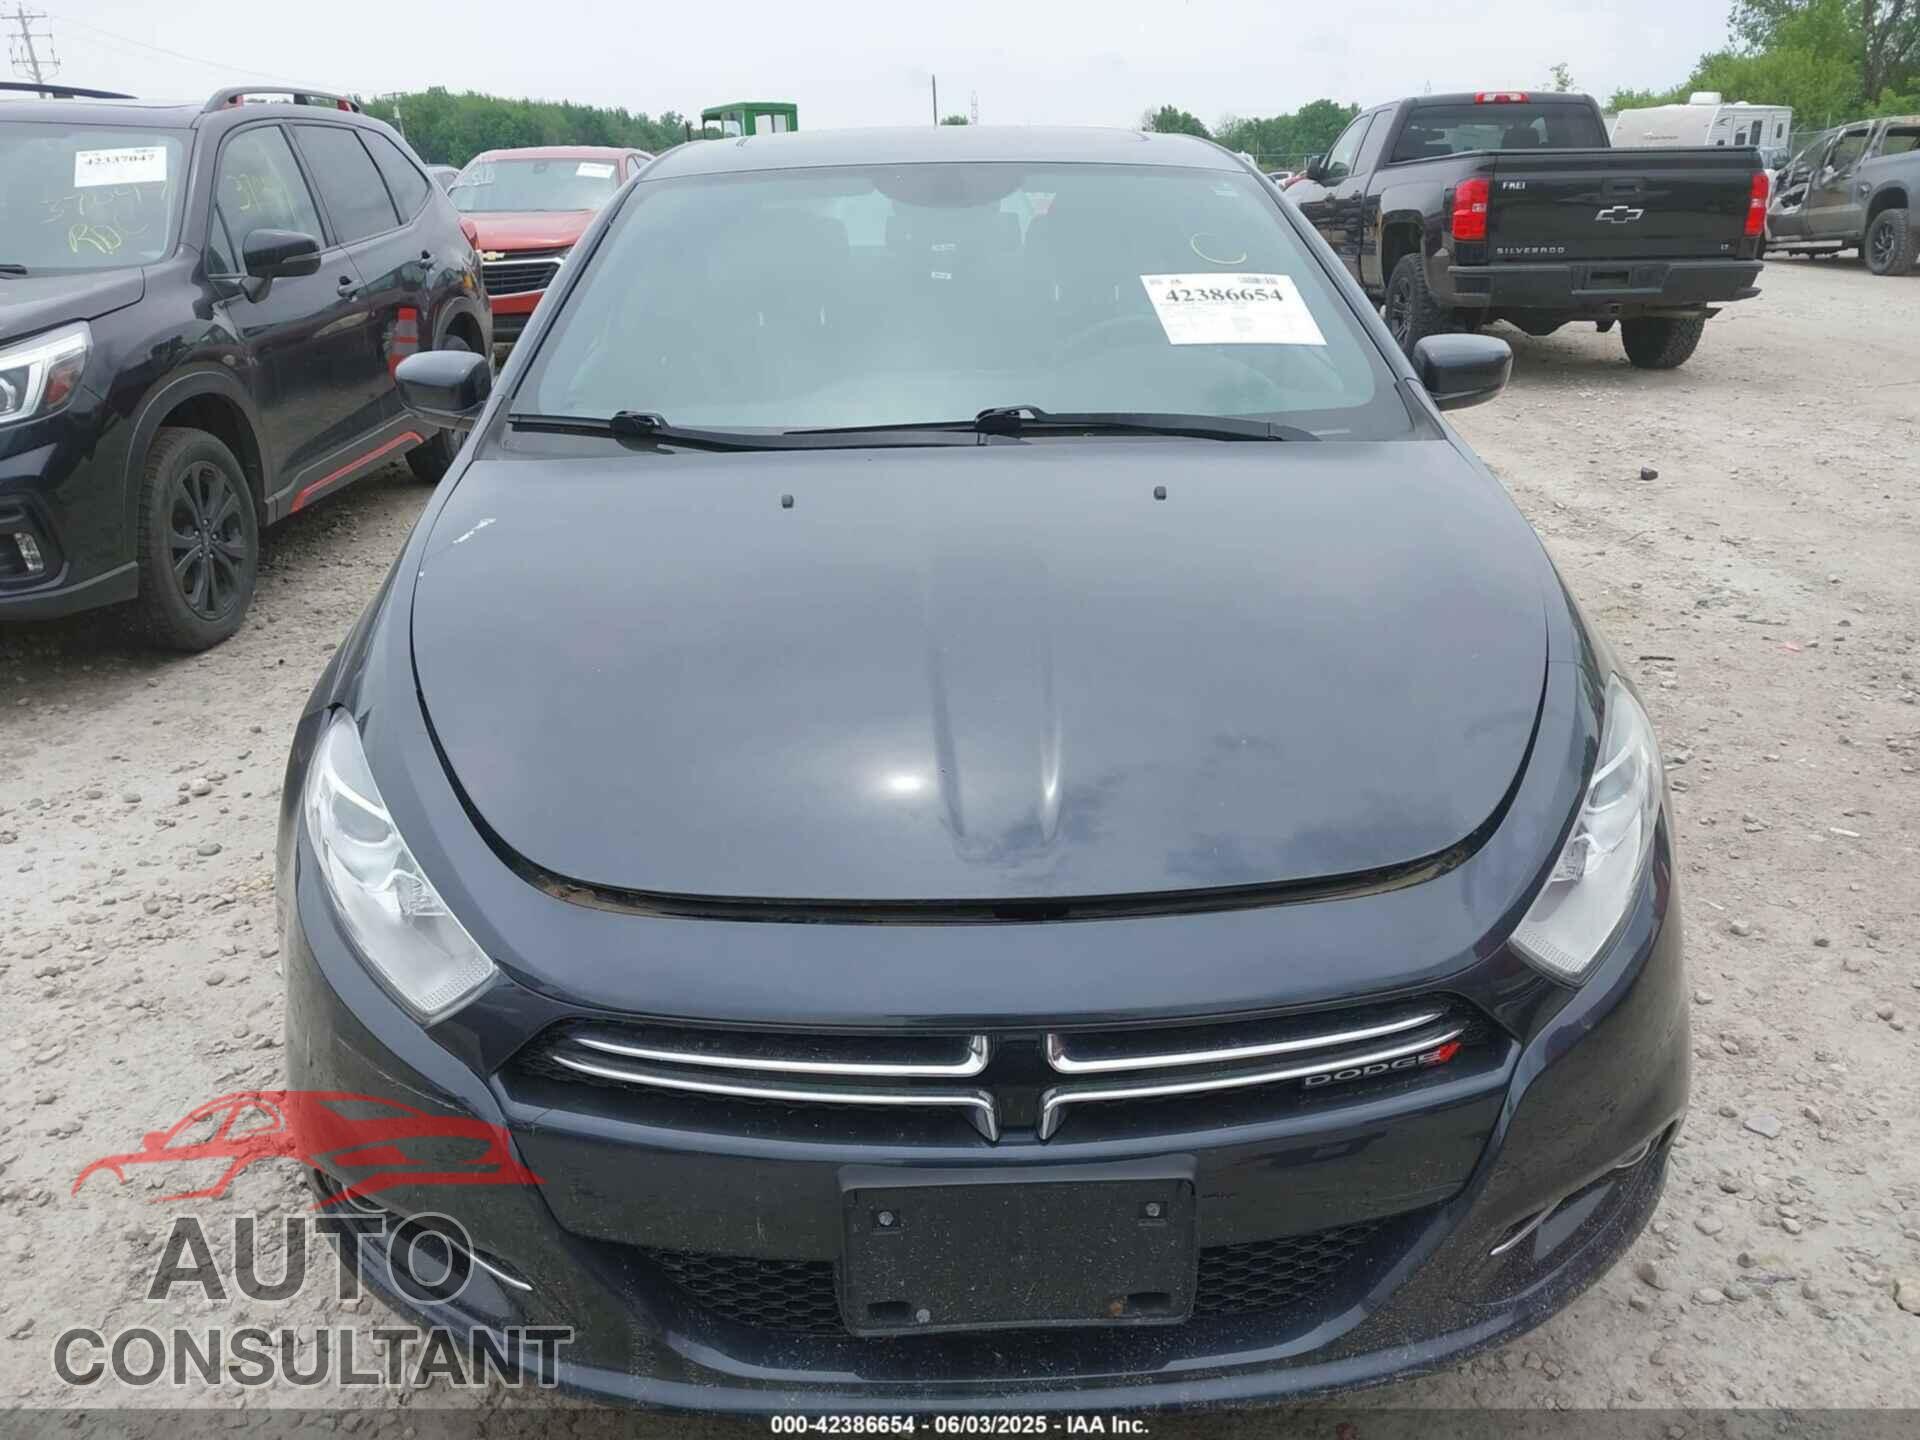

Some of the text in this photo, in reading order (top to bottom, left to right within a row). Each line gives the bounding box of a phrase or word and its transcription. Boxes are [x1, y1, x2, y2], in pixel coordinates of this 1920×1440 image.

[1496, 246, 1566, 255] SILVERADO
[1165, 288, 1284, 302] 42386654
[1304, 1050, 1442, 1087] DODGE
